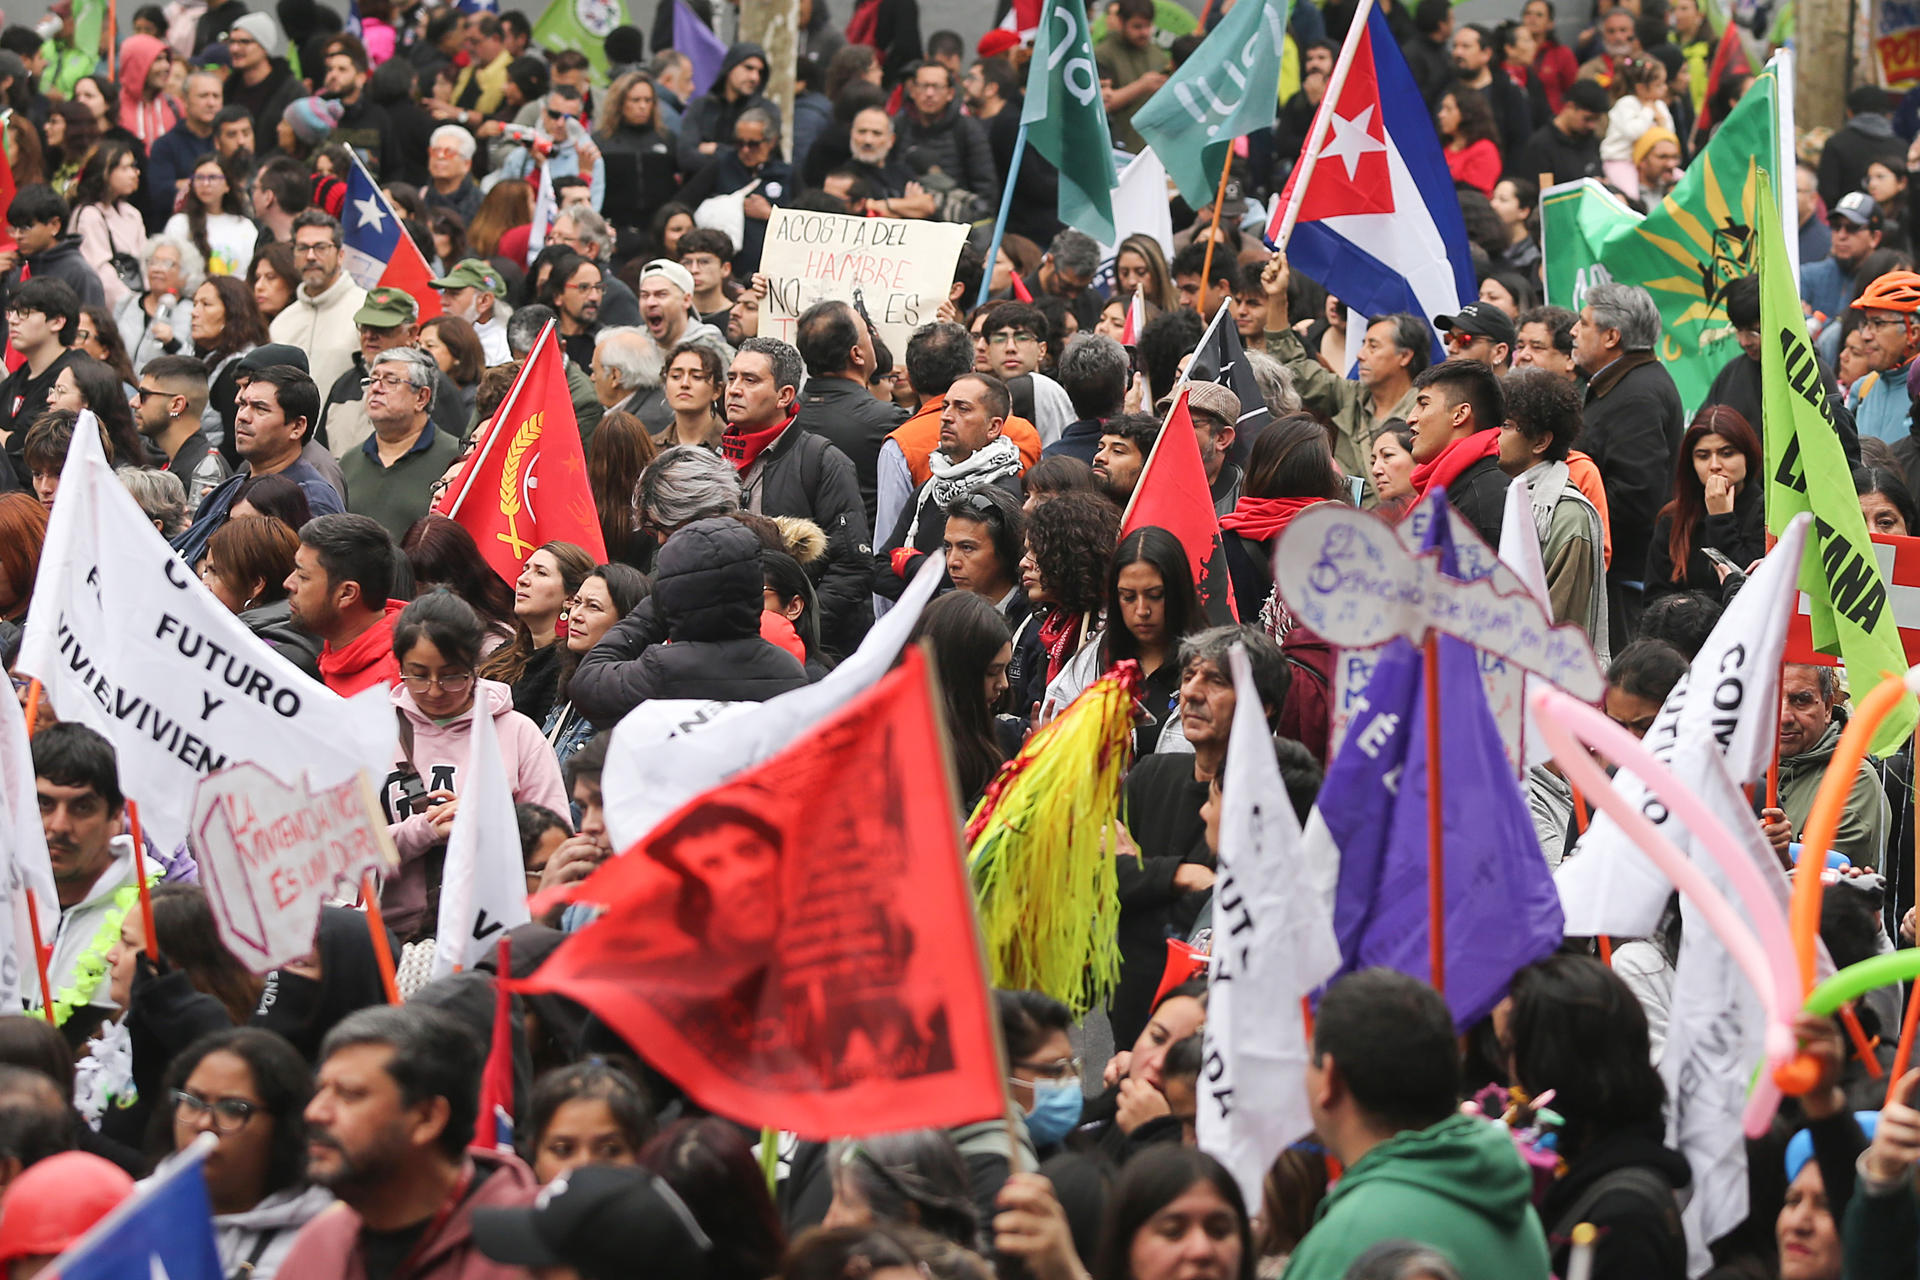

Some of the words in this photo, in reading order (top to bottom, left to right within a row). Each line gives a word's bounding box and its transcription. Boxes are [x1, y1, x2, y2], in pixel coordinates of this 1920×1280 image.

[871, 221, 908, 247] DEL
[804, 251, 913, 289] HAMBRE
[768, 277, 801, 318] NO
[885, 293, 920, 327] ES
[154, 613, 302, 719] FUTURO
[200, 690, 225, 721] Y
